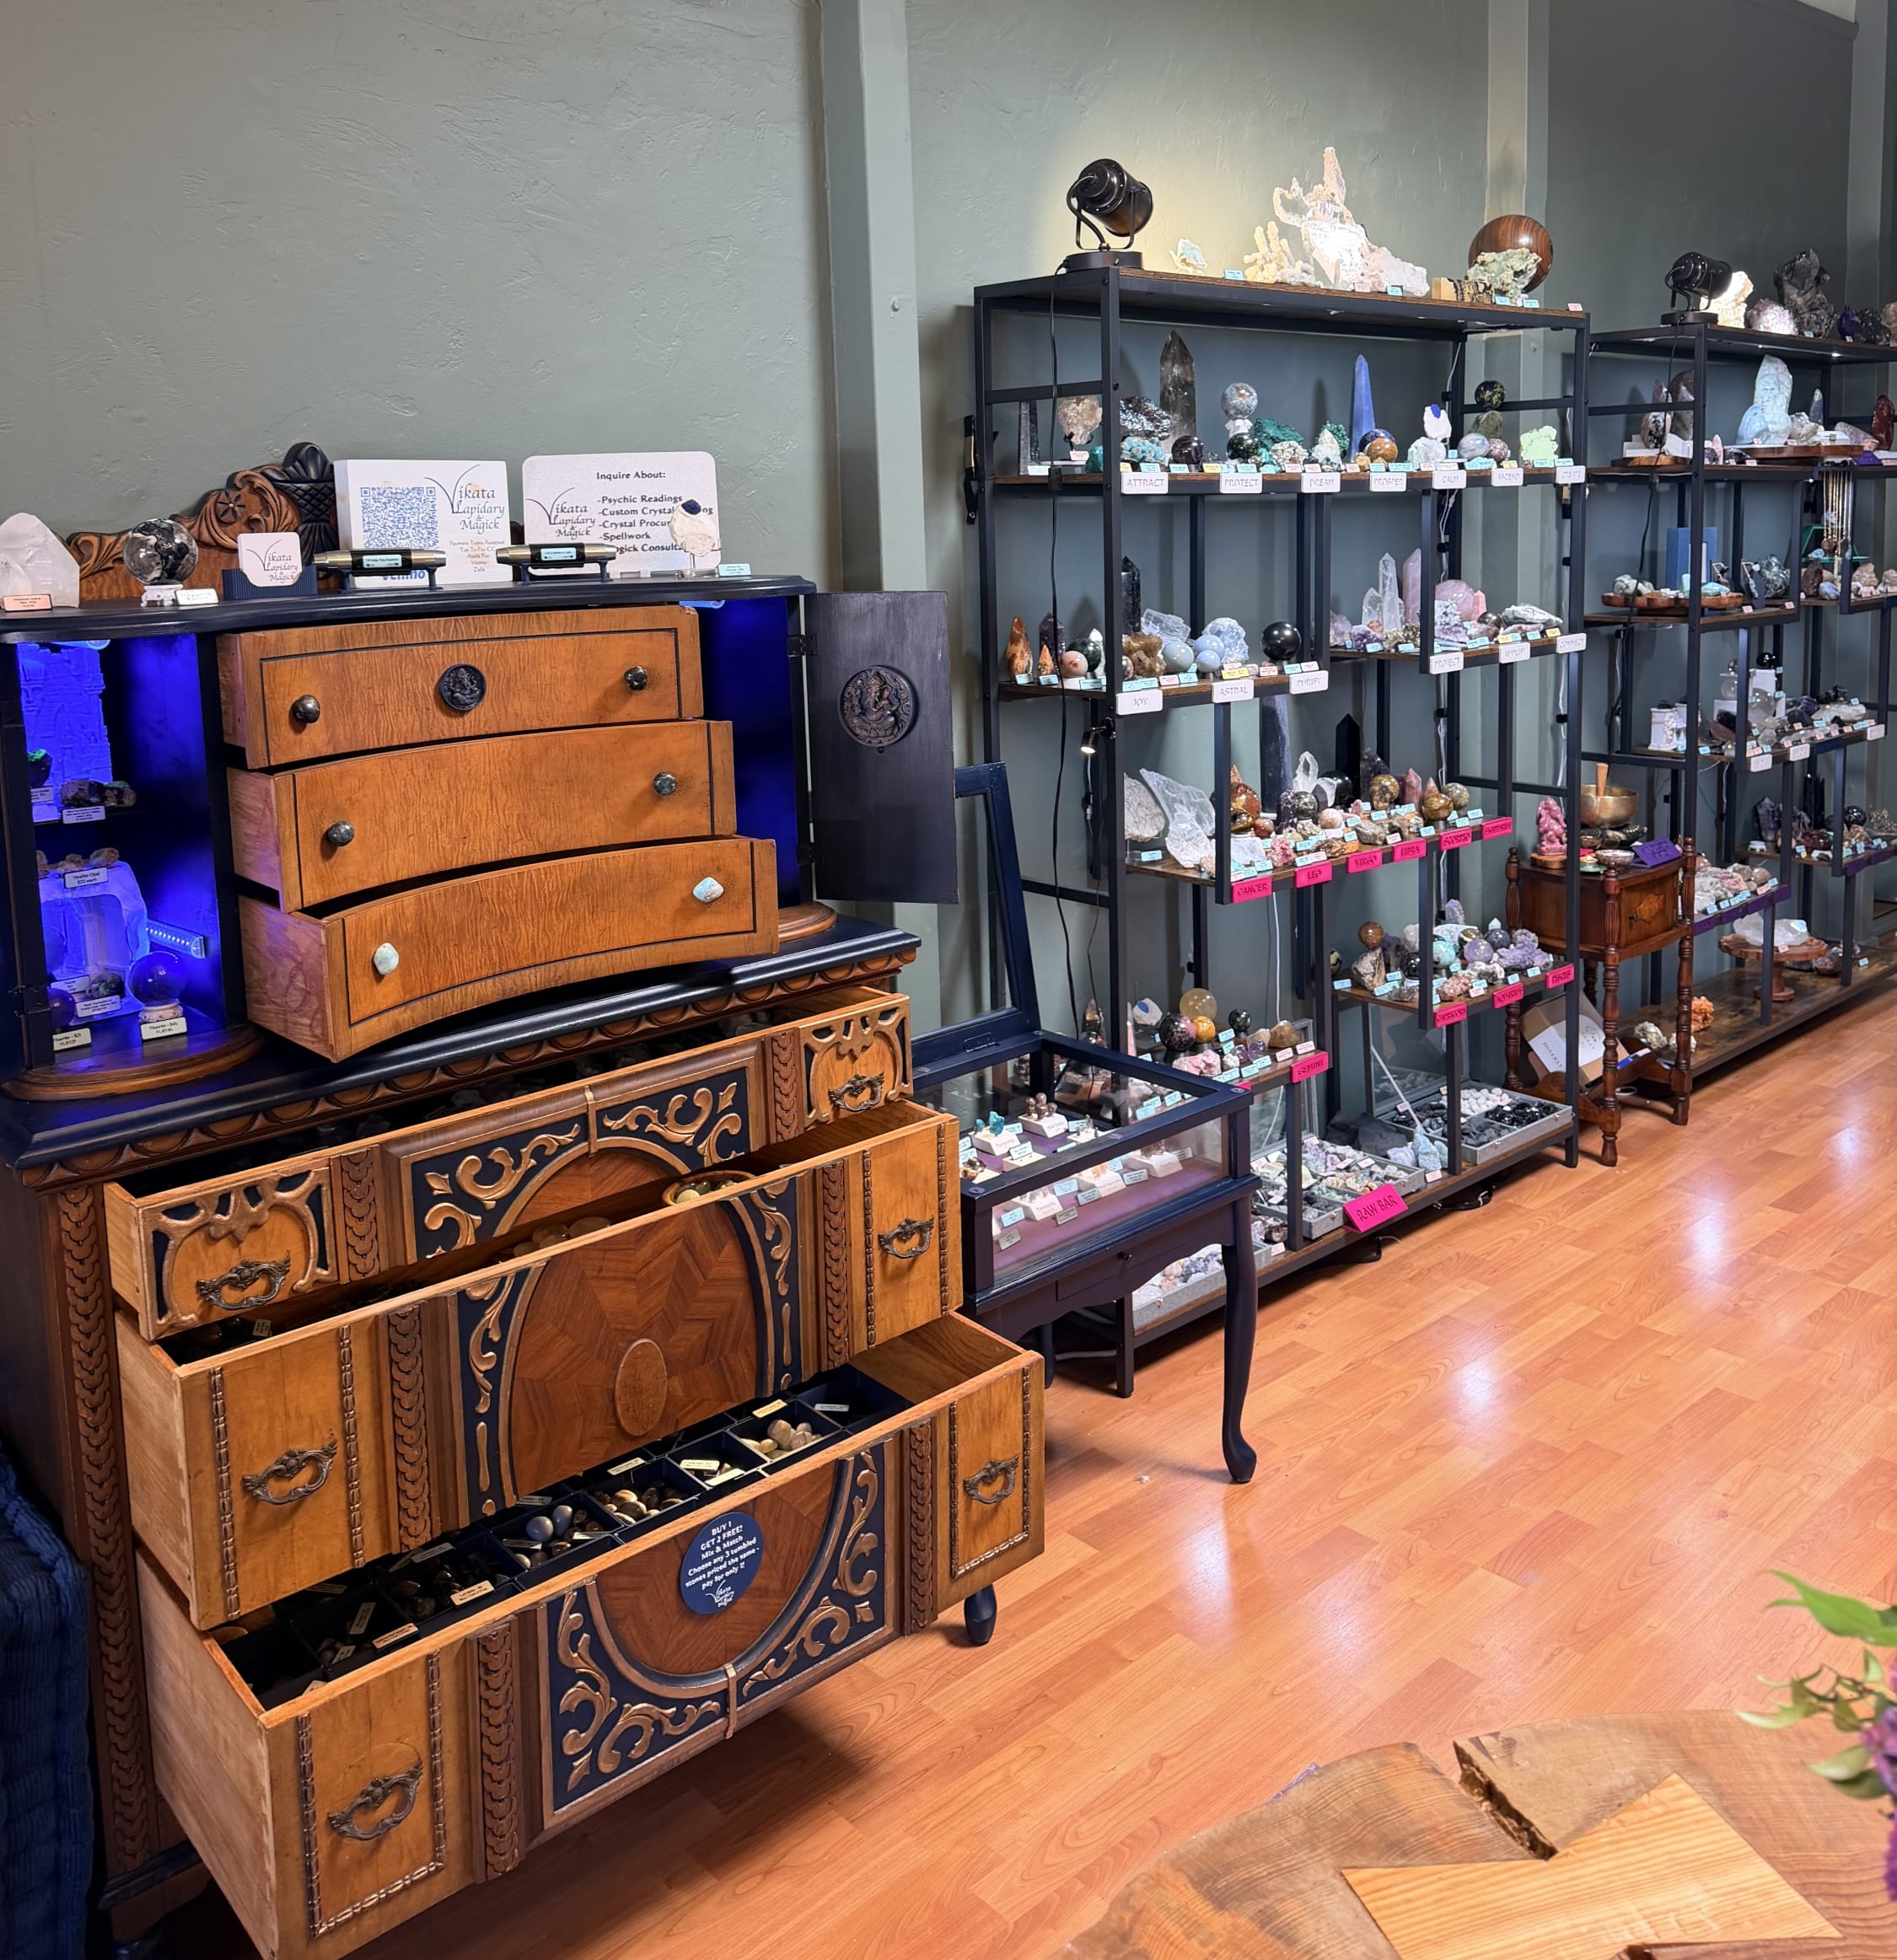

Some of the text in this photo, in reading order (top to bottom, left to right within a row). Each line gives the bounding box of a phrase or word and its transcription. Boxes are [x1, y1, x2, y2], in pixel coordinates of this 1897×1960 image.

[597, 470, 666, 481] Inquire About:
[1126, 478, 1164, 487] ATTRACT
[1224, 479, 1260, 487] PROTECT
[1309, 478, 1334, 486] DREAM
[1374, 478, 1404, 486] PROSPER
[641, 494, 683, 504] Readings
[456, 500, 505, 518] Lapidary
[642, 506, 674, 517] Crystal
[459, 517, 500, 534] Magick
[553, 514, 596, 529] Lapidary
[639, 518, 671, 527] Procur
[556, 527, 593, 540] Magick
[616, 544, 639, 555] agick
[1219, 687, 1249, 696] ASTRAL
[1134, 697, 1149, 706] JOY
[1400, 846, 1420, 856] LIBRA
[1355, 856, 1378, 867] VIRGO
[1308, 870, 1322, 879] LEO
[1237, 883, 1268, 896] CANCER
[1297, 1059, 1325, 1076] GEMINI
[1356, 1195, 1399, 1222] RAW BAR
[712, 1522, 728, 1536] BUY
[701, 1538, 715, 1551] GET
[723, 1524, 744, 1540] FREE!
[701, 1551, 715, 1560] Mix
[723, 1535, 744, 1549] Match
[688, 1560, 712, 1576] Choose
[713, 1555, 724, 1565] any
[730, 1537, 756, 1555] tumbled
[685, 1573, 707, 1588] stones
[707, 1561, 727, 1578] priced
[728, 1557, 739, 1566] the
[739, 1549, 756, 1560] same
[701, 1580, 713, 1591] pay
[714, 1573, 724, 1582] for
[725, 1565, 739, 1577] only
